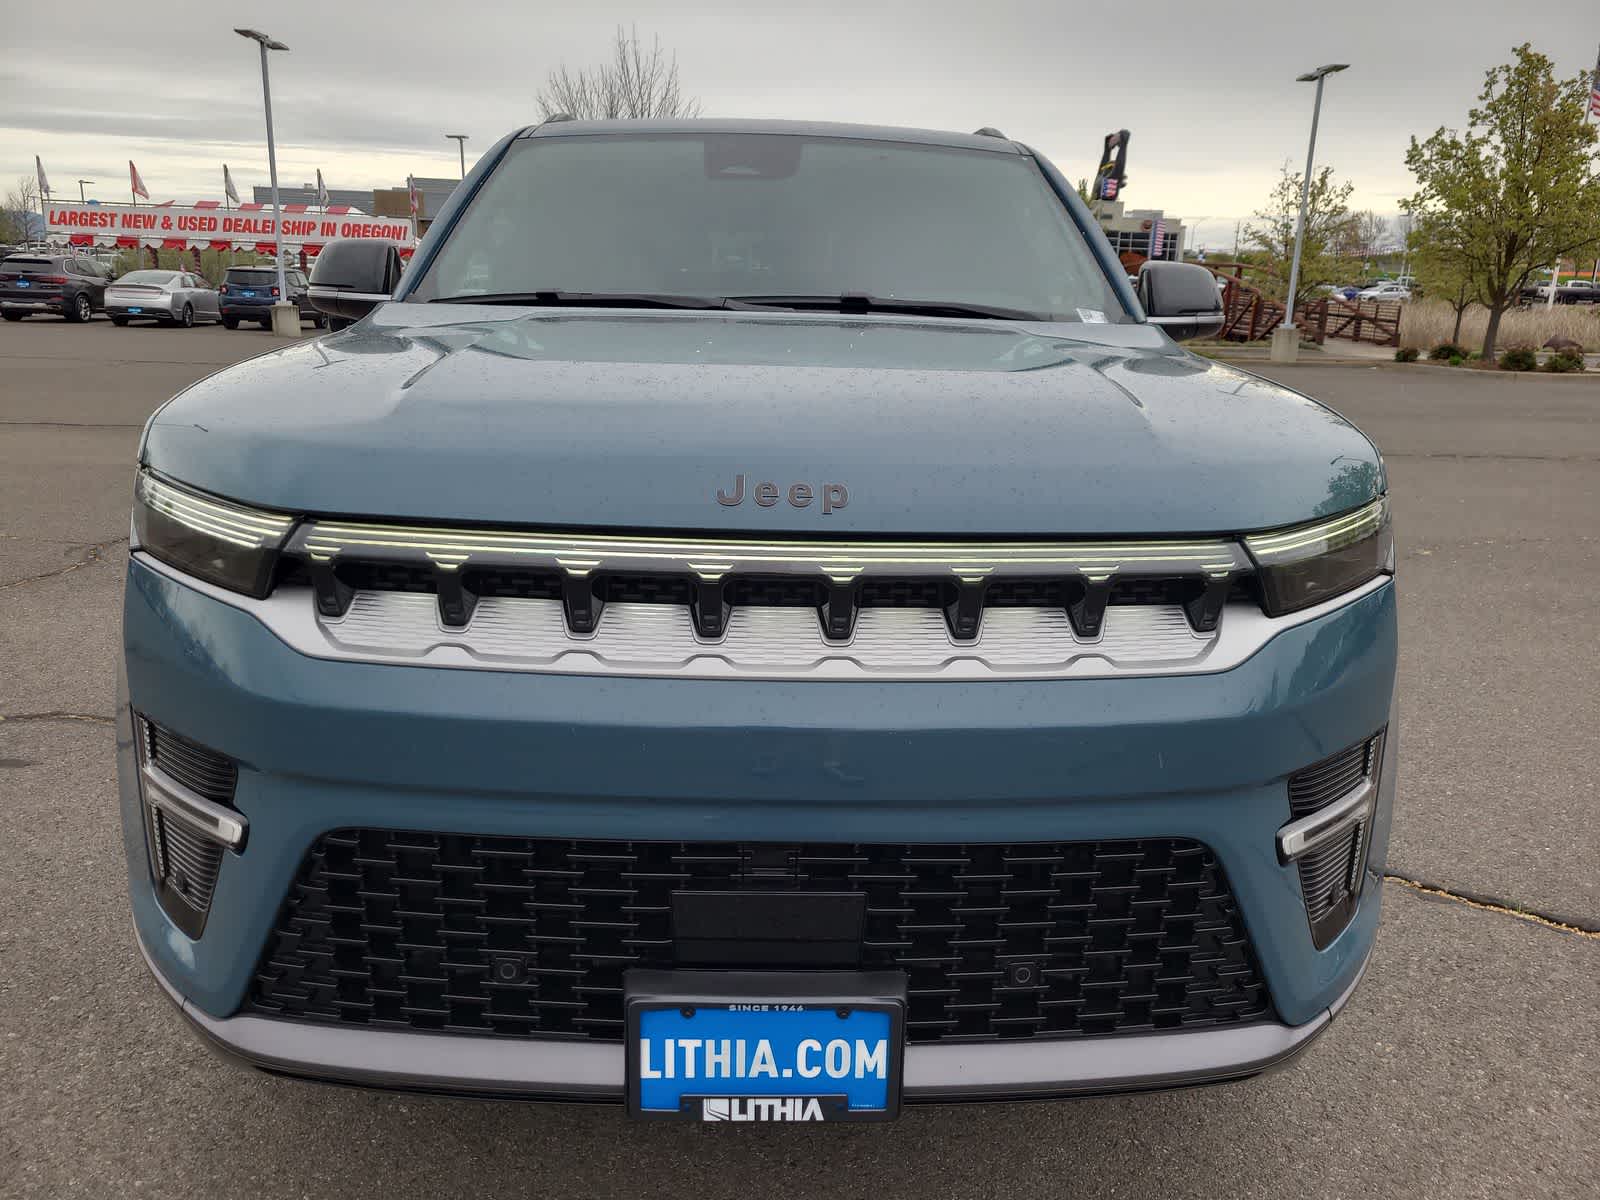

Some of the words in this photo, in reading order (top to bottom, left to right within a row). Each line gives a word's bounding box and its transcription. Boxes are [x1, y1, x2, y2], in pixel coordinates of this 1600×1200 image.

[49, 210, 117, 228] LARGEST
[121, 213, 157, 230] NEW
[161, 215, 173, 231] &
[178, 215, 217, 232] USED
[320, 222, 337, 237] IN
[341, 223, 408, 240] OREGON!
[716, 474, 849, 515] Jeep
[728, 1004, 769, 1012] SINCE
[774, 1004, 805, 1012] 1946
[640, 1038, 887, 1079] LITHIA.COM
[731, 1098, 825, 1121] LITHIA
